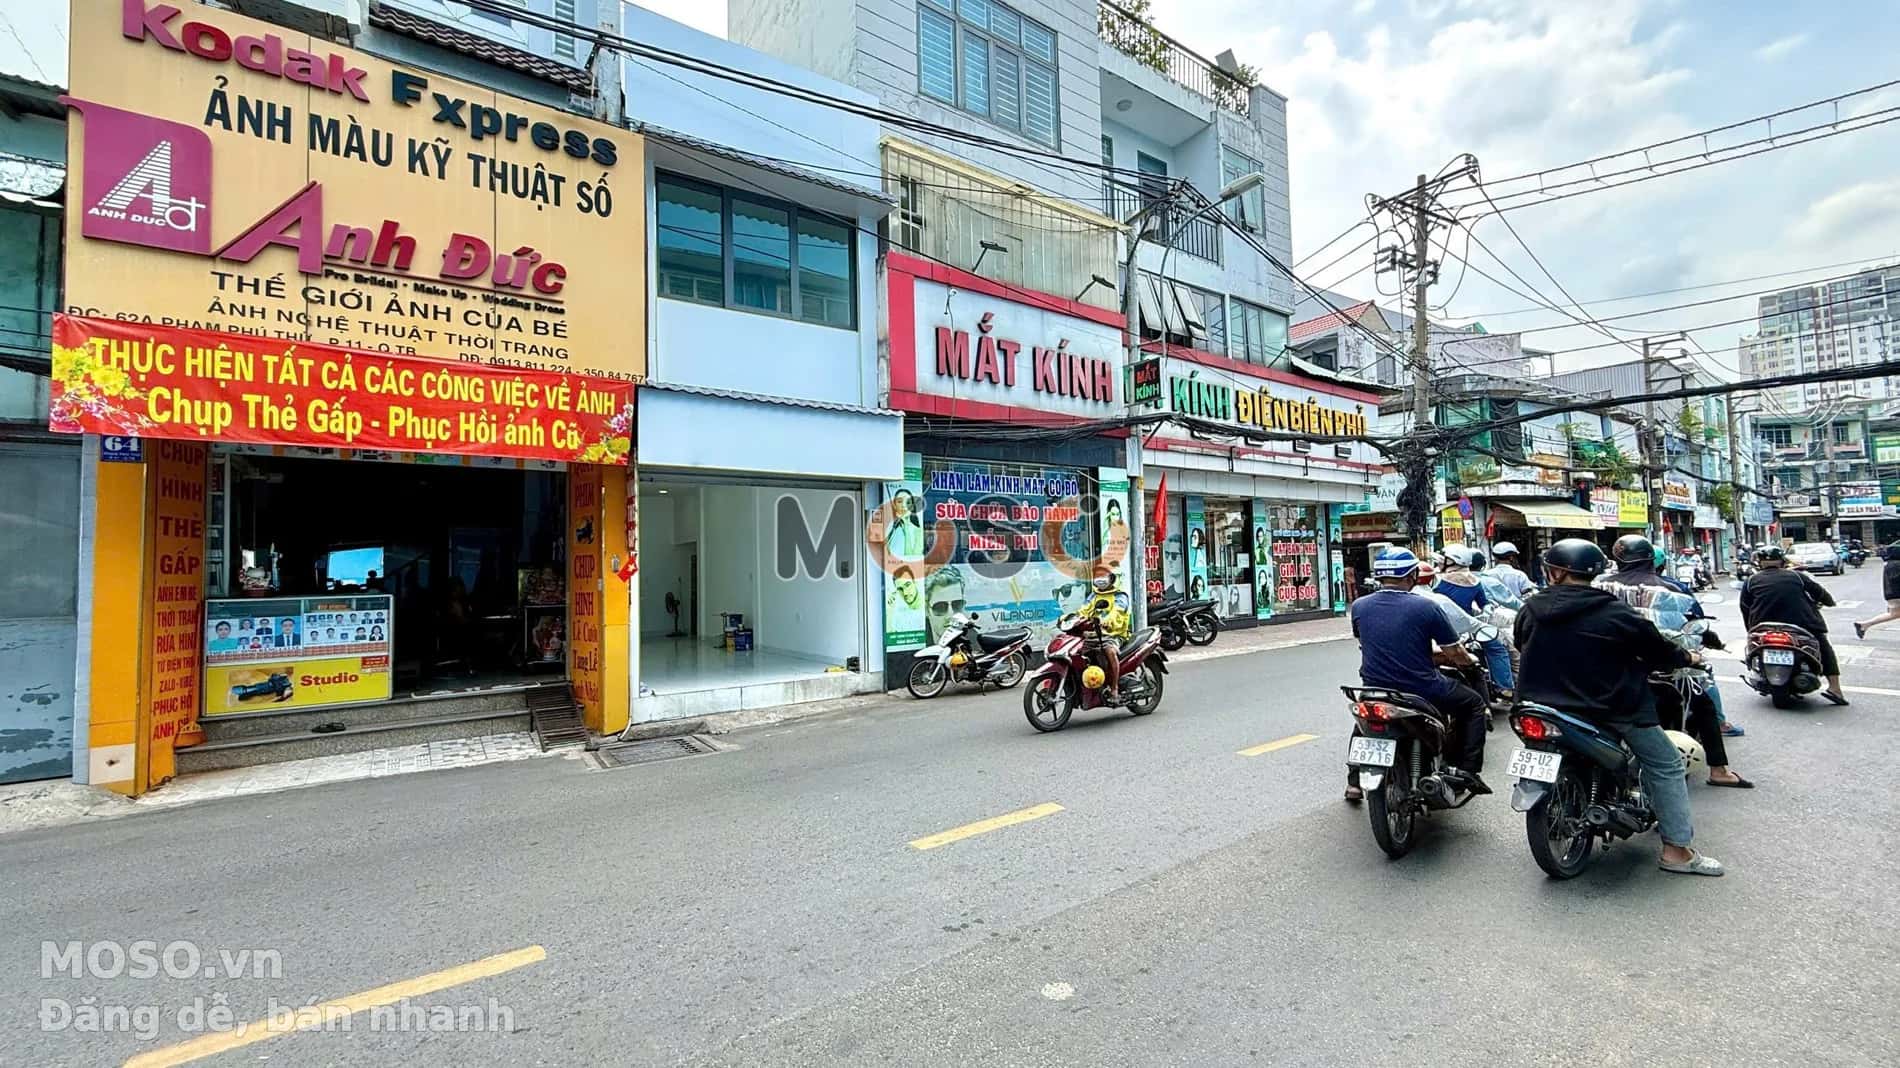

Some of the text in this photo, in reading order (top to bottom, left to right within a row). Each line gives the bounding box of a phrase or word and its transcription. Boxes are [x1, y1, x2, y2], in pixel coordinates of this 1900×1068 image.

[122, 0, 370, 103] Kodak
[204, 75, 613, 218] ẢNH MÀU KỸ THUẬT SỐ
[88, 207, 167, 227] ANH DUC
[214, 180, 567, 294] Anh Đức
[325, 268, 349, 282] Pro
[413, 283, 448, 297] Make
[451, 289, 468, 300] Up
[211, 271, 569, 340] THẾ GIỚI ẢNH CỦA BÉ
[208, 296, 266, 320] ẢNH
[358, 320, 437, 344] THUẬT
[444, 331, 494, 350] THỜI
[501, 339, 569, 360] TRANG
[936, 312, 1021, 387] MẮT
[1033, 338, 1113, 402] KÍNH
[89, 336, 616, 417] THỰC HIỆN TẤT CẢ CÁC CÔNG VIỆC VỀ ẢNH
[1136, 362, 1158, 384] MẮT
[1136, 383, 1160, 400] KÍNH
[1170, 370, 1231, 420] KÍNH
[1235, 386, 1288, 432] ĐIỆN
[147, 386, 234, 436] Chụp
[242, 394, 298, 432] Thẻ
[307, 396, 363, 444] Gấp
[388, 405, 451, 449] Phục
[460, 411, 497, 445] Hồi
[505, 414, 545, 447] ảnh
[551, 420, 581, 450] Cũ
[104, 436, 139, 451] 64
[931, 470, 964, 496] NHẬN
[967, 468, 992, 493] LÀM
[994, 471, 1020, 494] KÍNH
[1023, 473, 1045, 496] MẮT
[1049, 475, 1062, 496] CÓ
[936, 498, 1078, 522] SỬA CHỮA BẢO HÀNH
[969, 528, 1038, 550] MIỄN PHÍ
[160, 547, 200, 575] GẤP
[300, 672, 359, 687] Studio
[1518, 751, 1553, 767] 59-U2
